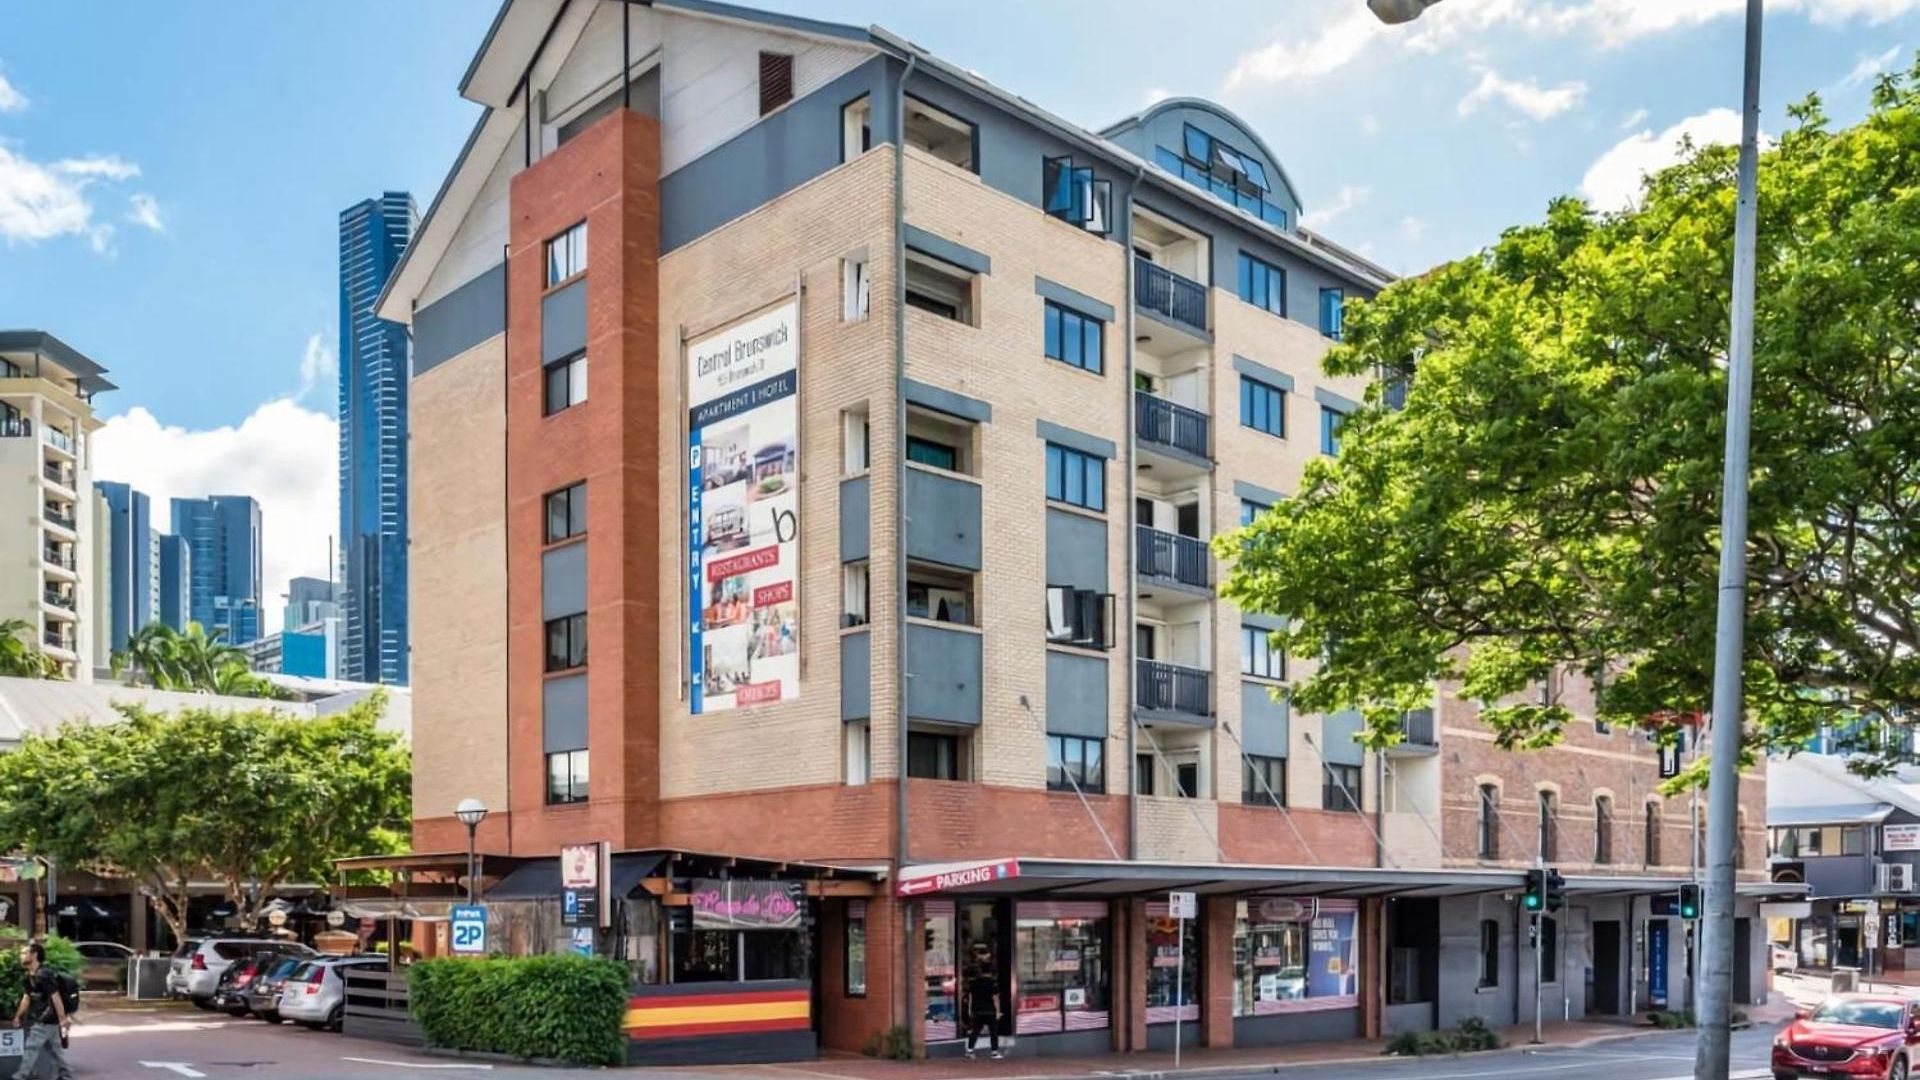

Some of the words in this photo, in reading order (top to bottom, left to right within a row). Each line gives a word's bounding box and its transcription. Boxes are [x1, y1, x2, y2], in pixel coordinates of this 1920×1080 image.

[698, 342, 731, 378] Central
[735, 321, 788, 362] Brunswick
[697, 393, 749, 422] APARTMENT
[758, 379, 788, 401] HOTEL
[691, 487, 700, 590] ENTRY
[711, 549, 776, 576] RESTAURANTS
[757, 584, 789, 604] SHOPS
[936, 868, 991, 890] PARKING
[565, 891, 576, 913] P
[455, 926, 482, 945] 2P
